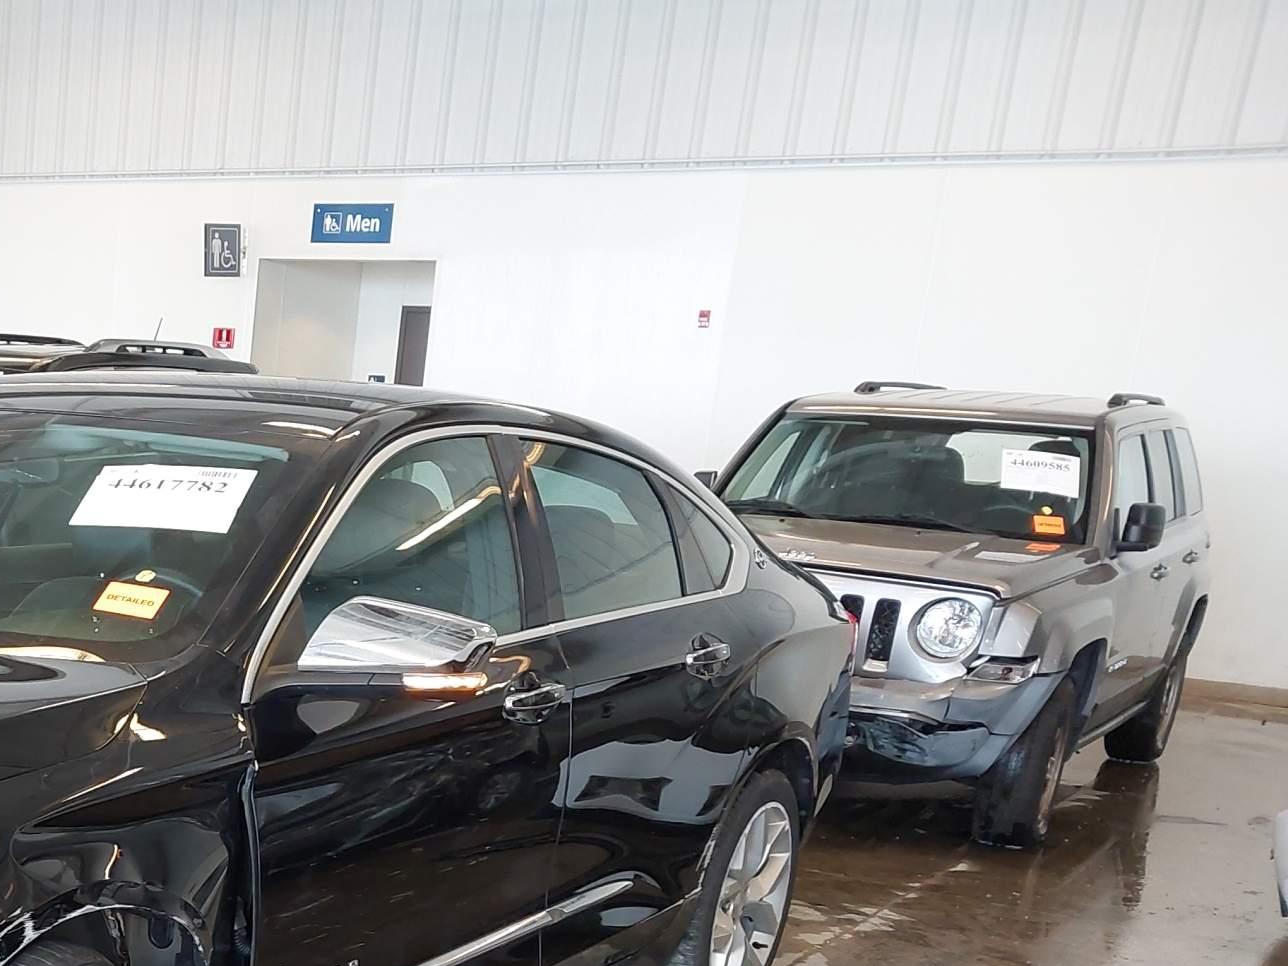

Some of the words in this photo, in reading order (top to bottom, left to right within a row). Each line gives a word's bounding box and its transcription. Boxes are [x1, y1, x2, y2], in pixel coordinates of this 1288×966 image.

[345, 214, 380, 232] Men
[1011, 459, 1071, 472] 44609585
[108, 478, 228, 493] 44617782
[106, 593, 155, 607] DETAILED
